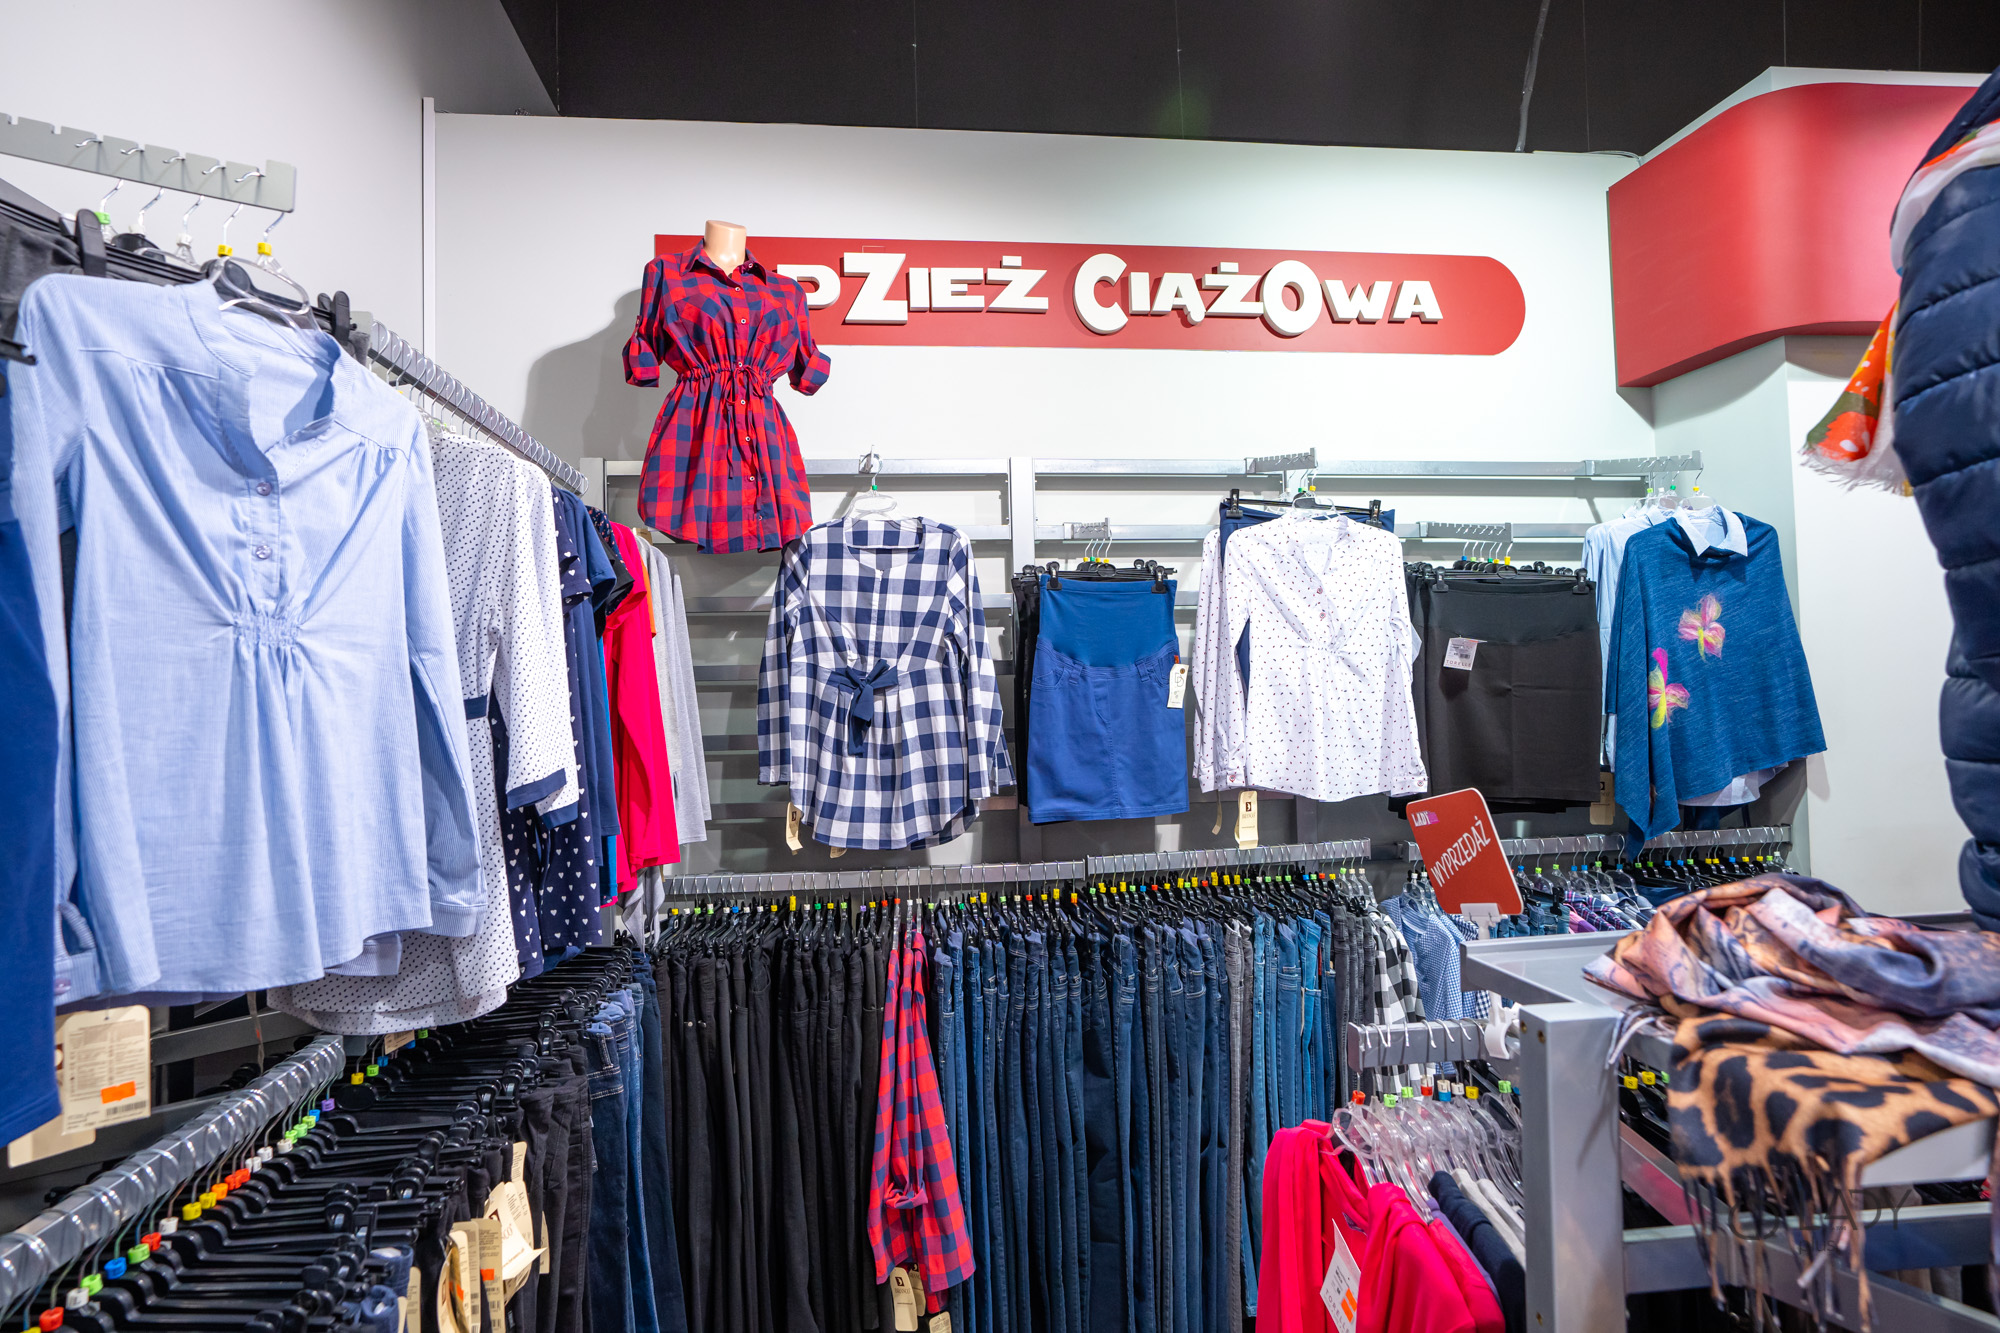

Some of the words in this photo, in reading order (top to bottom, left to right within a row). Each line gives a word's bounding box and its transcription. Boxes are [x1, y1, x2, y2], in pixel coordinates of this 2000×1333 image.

[777, 252, 1048, 324] DZIEŻ
[1074, 253, 1443, 336] CIĄŻOWA
[1411, 810, 1431, 827] LADY
[1430, 815, 1491, 888] WYPRZEDAŻ
